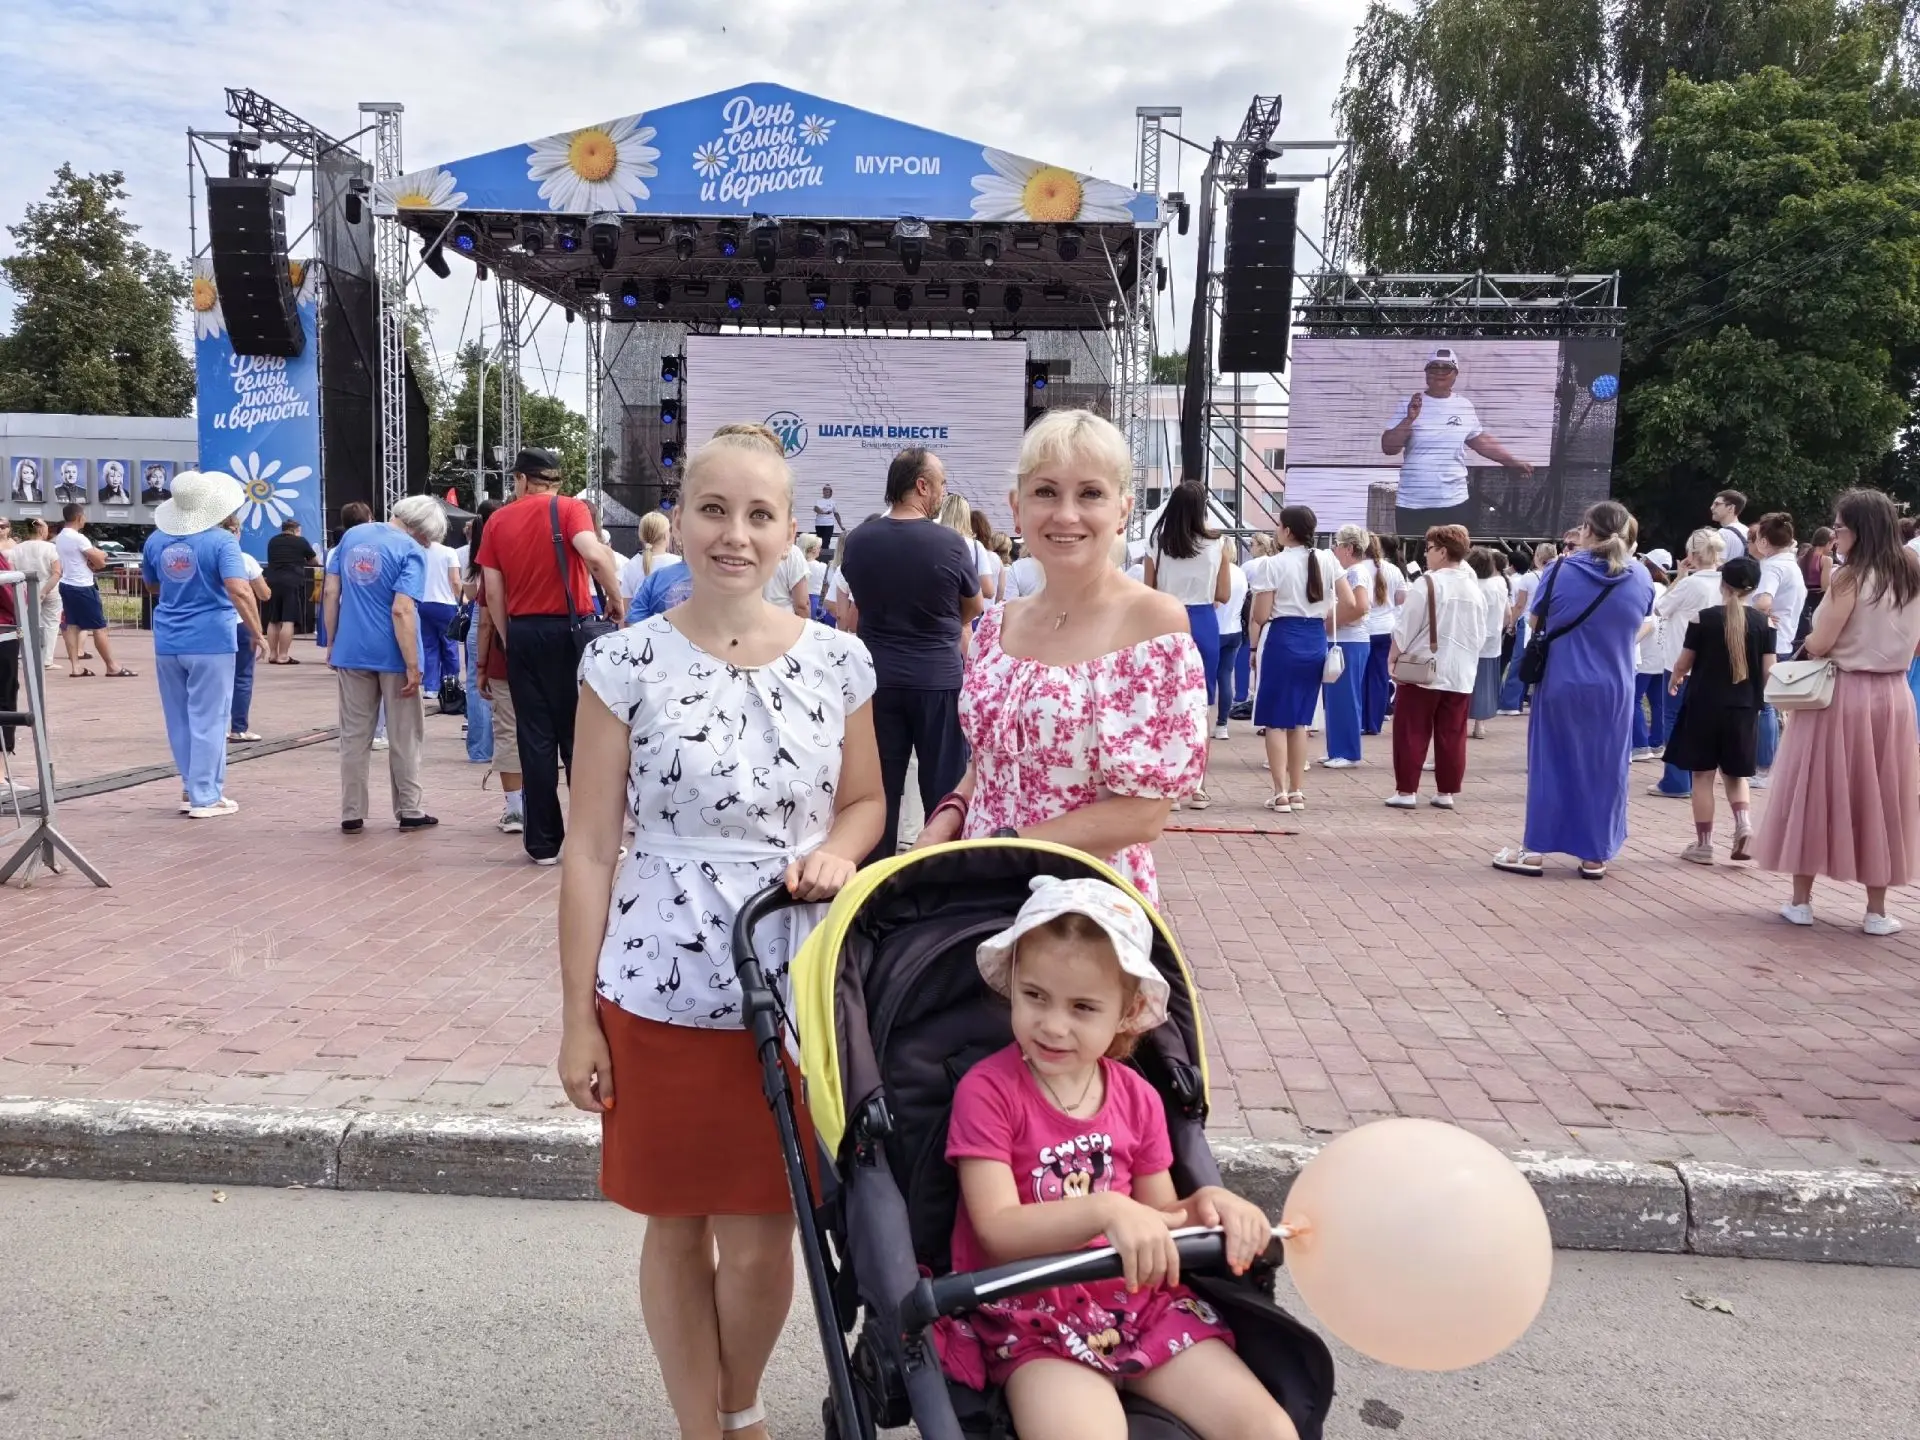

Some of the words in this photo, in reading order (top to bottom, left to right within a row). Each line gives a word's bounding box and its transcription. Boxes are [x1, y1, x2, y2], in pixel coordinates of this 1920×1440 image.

[722, 96, 795, 134] День
[728, 124, 797, 155] семьи,
[731, 147, 812, 174] любви
[855, 155, 940, 175] МУРОМ
[701, 181, 716, 201] и
[719, 165, 823, 207] верности
[239, 385, 301, 408] любви
[213, 413, 226, 429] и
[229, 401, 310, 433] верности
[818, 424, 884, 438] ШАГАЕМ
[887, 426, 949, 439] ВМЕСТЕ
